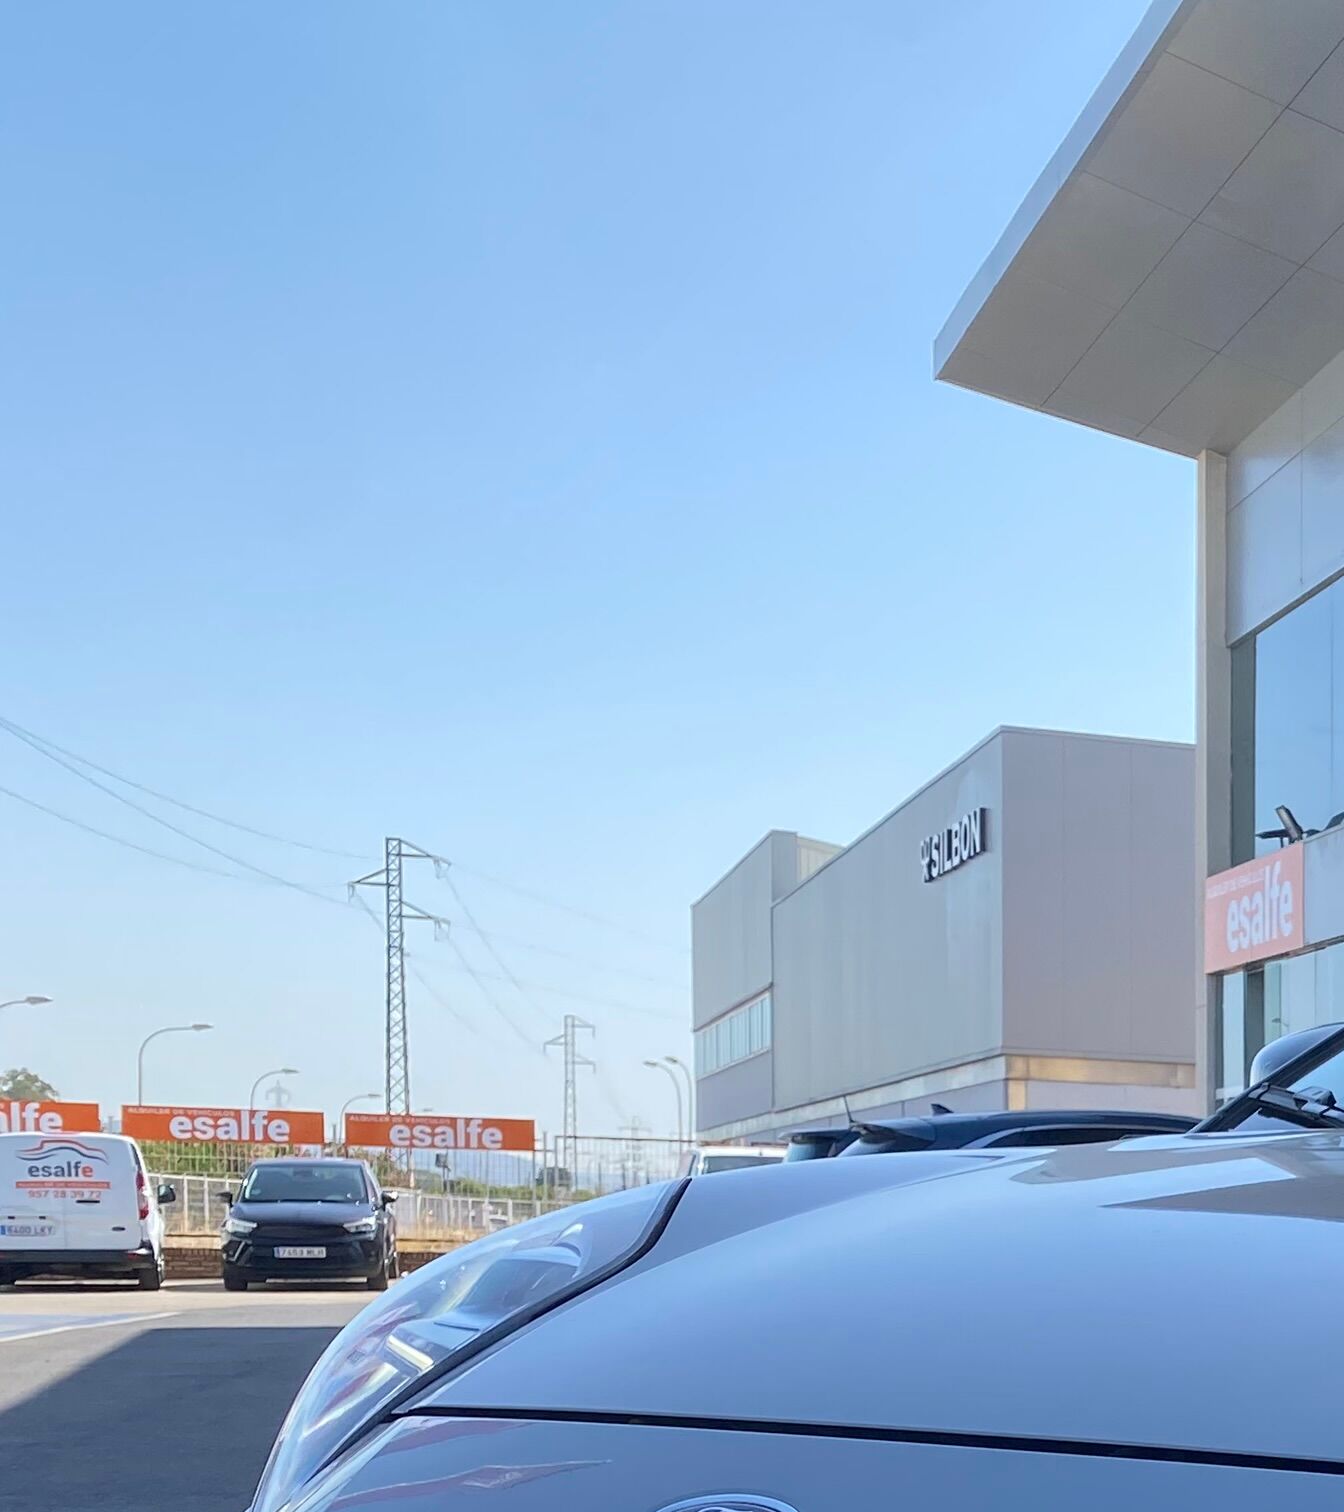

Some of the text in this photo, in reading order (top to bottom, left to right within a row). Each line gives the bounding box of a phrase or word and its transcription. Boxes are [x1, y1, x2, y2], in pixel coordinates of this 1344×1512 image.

[931, 807, 985, 879] SILBON
[1226, 860, 1293, 953] esalfe
[0, 1102, 63, 1132] lfe
[169, 1110, 290, 1142] esalfe
[389, 1118, 503, 1150] esalfe
[28, 1161, 93, 1177] esalfe
